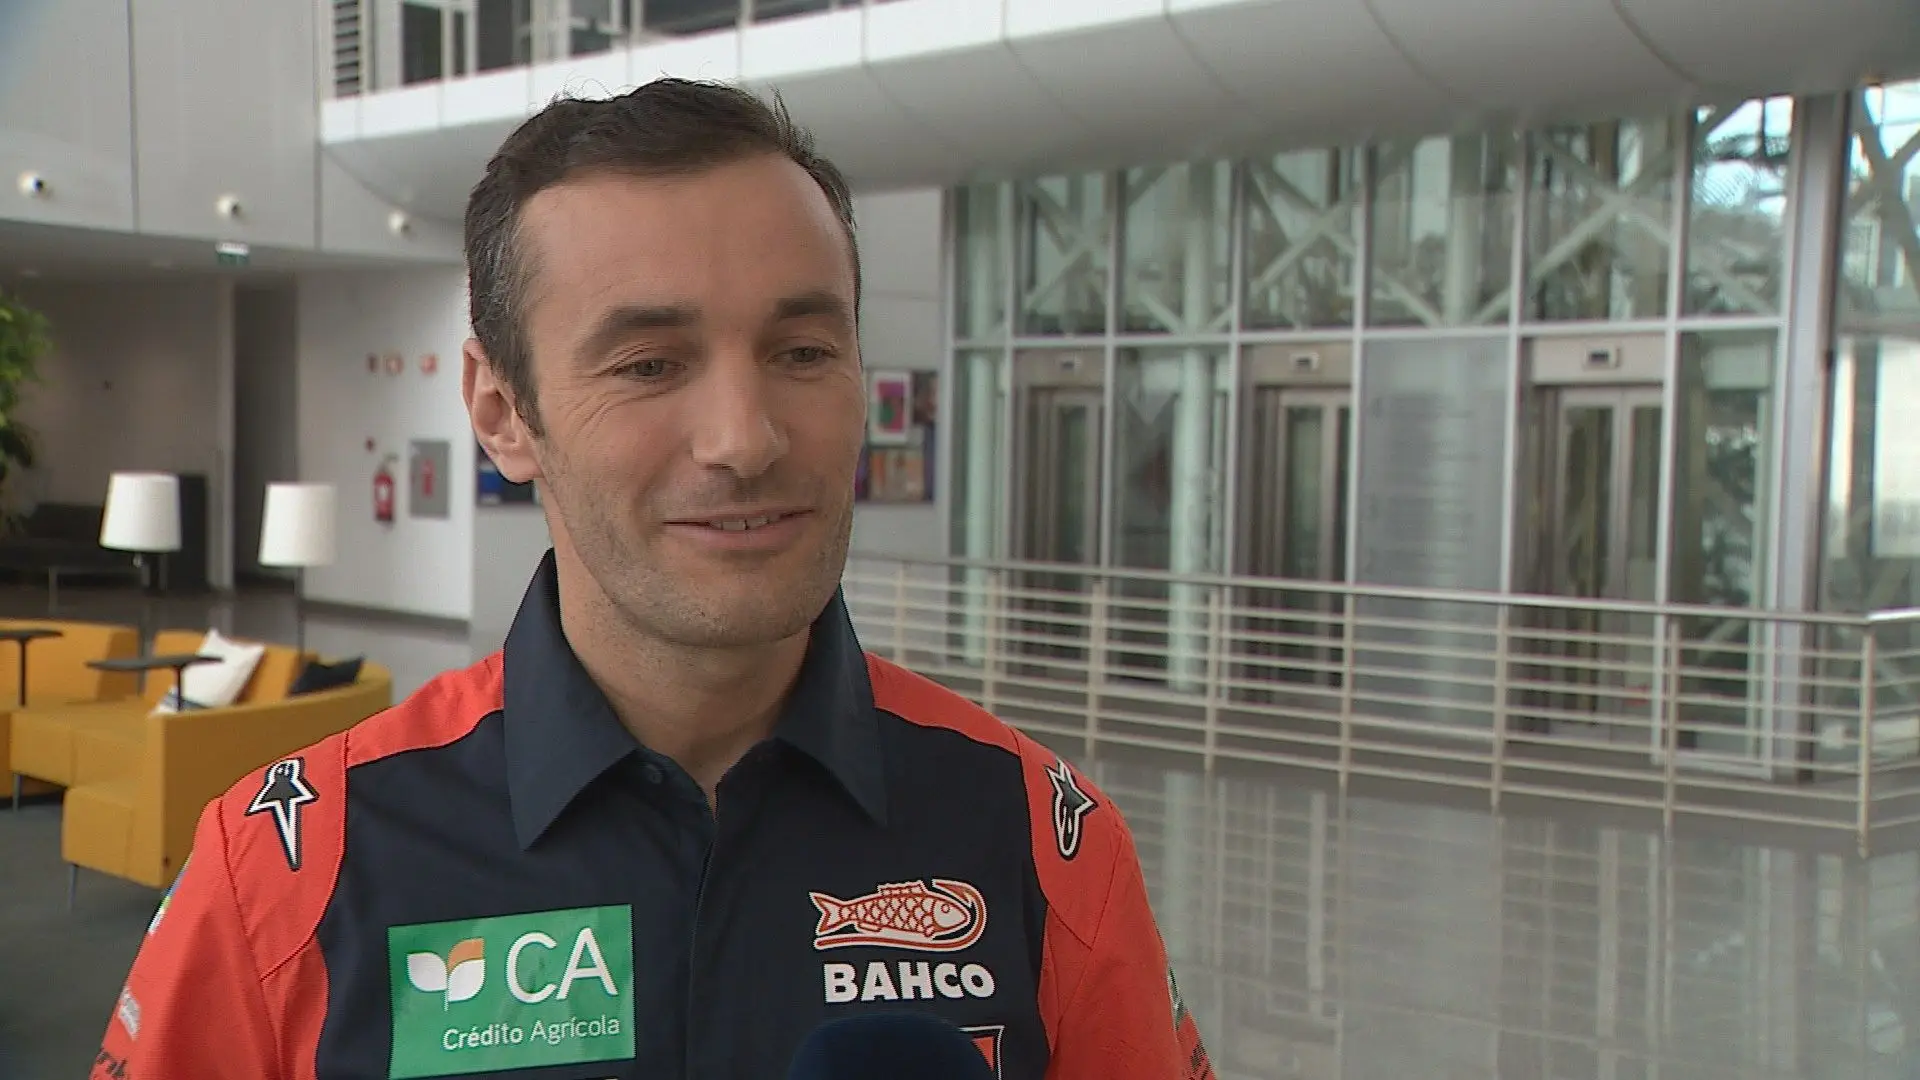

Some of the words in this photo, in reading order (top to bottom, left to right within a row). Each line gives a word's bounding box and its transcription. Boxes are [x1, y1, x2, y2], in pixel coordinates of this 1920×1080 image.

[506, 927, 619, 1004] CA
[823, 961, 995, 1003] BAHCO
[443, 1022, 524, 1051] Crédito
[530, 1015, 620, 1045] Agrícola
